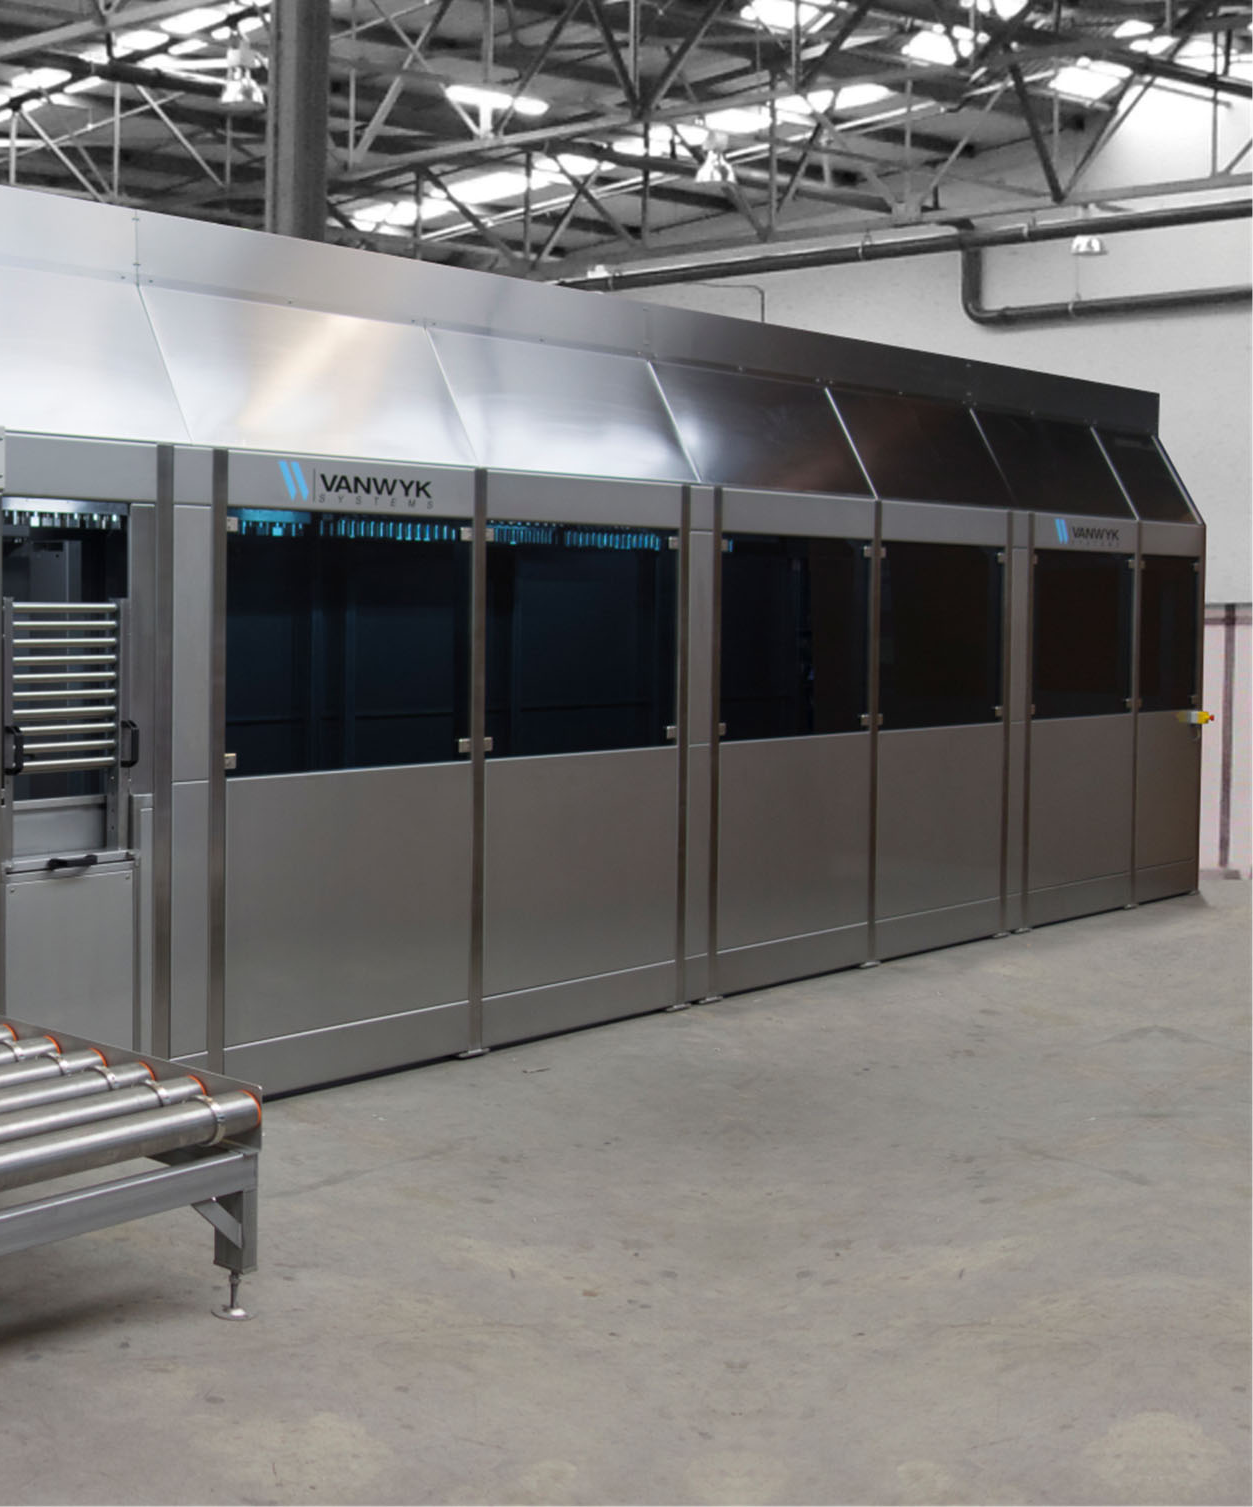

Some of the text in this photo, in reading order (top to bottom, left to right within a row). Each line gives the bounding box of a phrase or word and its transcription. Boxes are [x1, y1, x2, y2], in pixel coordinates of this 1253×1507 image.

[320, 473, 432, 498] VANWYK
[319, 494, 434, 509] SYSTEMS
[1072, 526, 1120, 540] VANWYK
